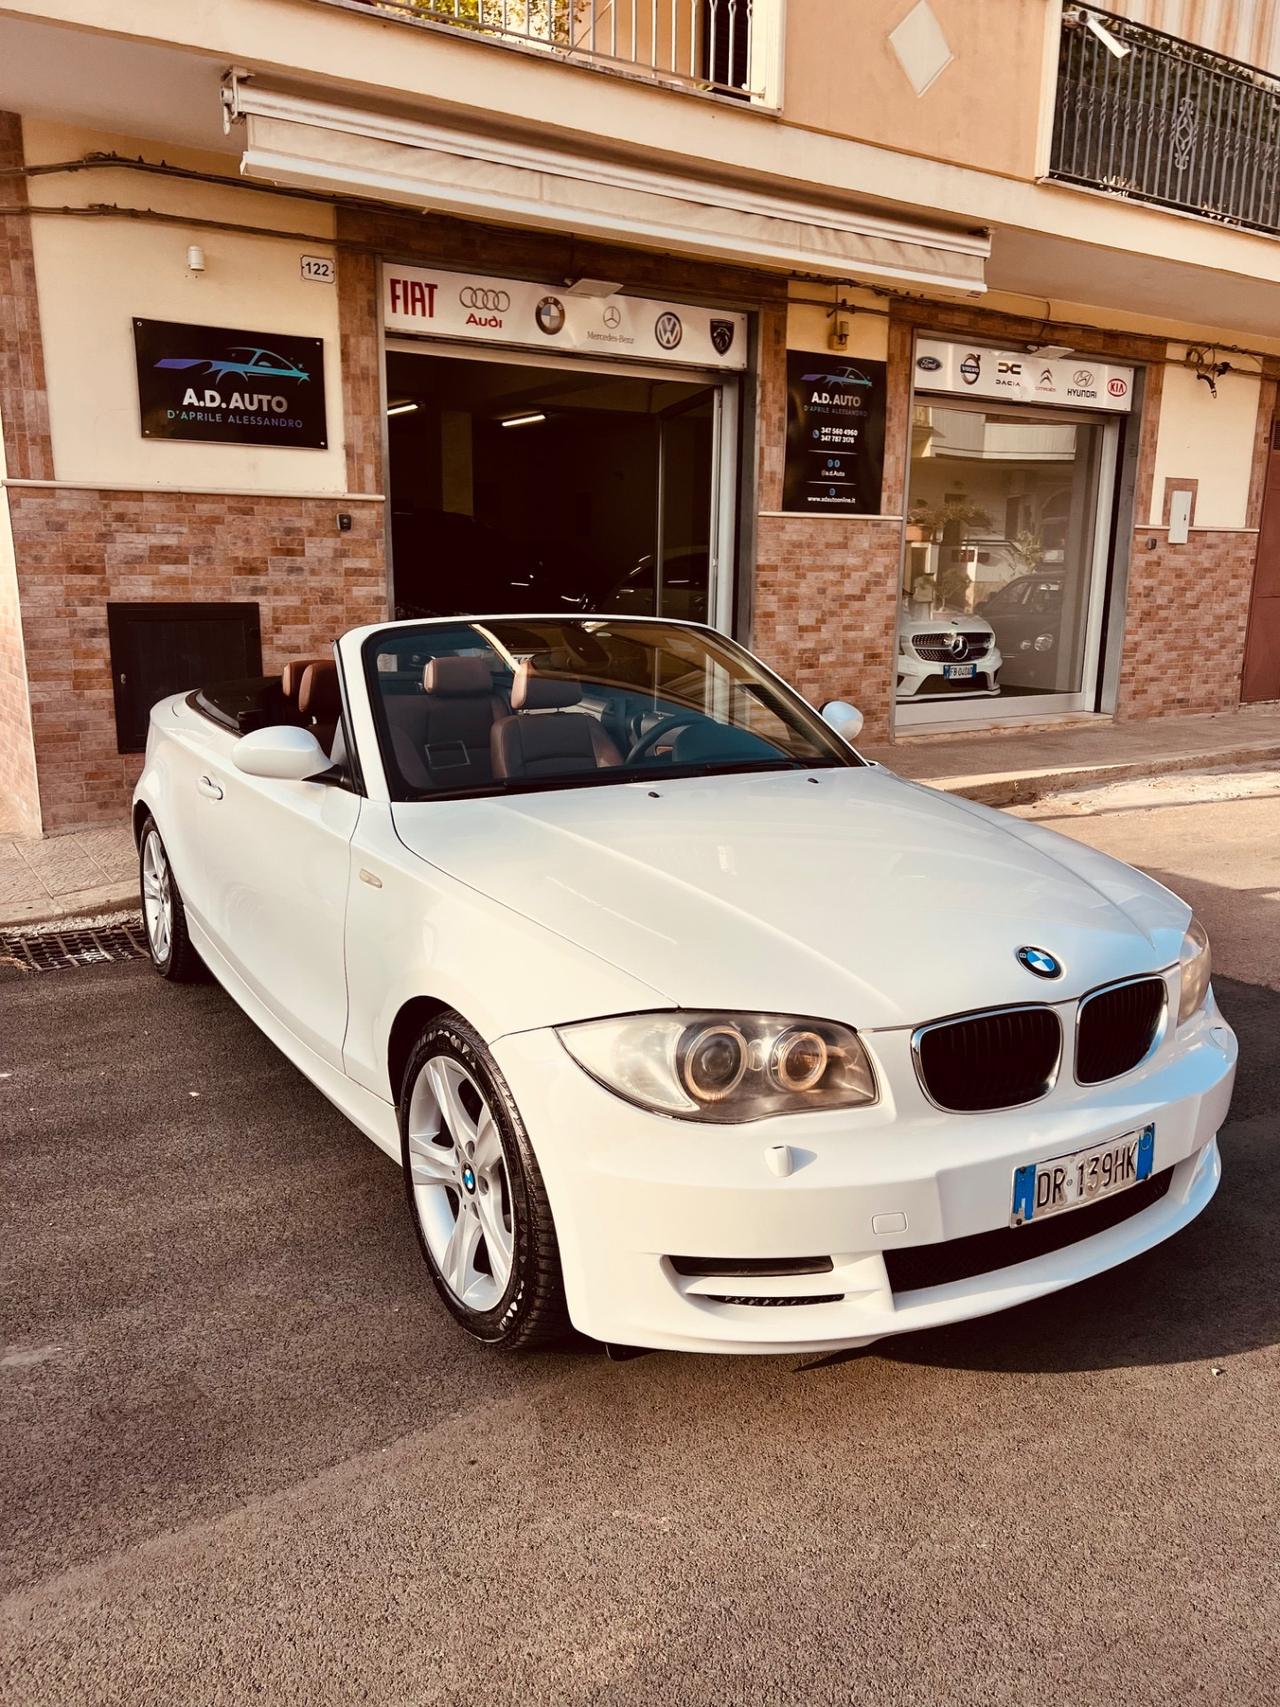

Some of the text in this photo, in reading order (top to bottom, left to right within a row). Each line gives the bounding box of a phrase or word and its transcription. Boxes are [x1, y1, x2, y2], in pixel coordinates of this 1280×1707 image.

[305, 262, 329, 276] 122
[390, 278, 438, 318] FIAT
[466, 313, 502, 328] Audi
[587, 330, 635, 344] Mercedes-Benz
[920, 358, 938, 369] Ford
[995, 379, 1021, 387] DACIA
[1110, 382, 1124, 393] KIA
[182, 388, 288, 413] A.D. AUTO
[811, 391, 861, 407] A.D. AUTO
[1067, 388, 1097, 399] HYUNDAI
[167, 409, 303, 428] D'APRILE ALESSANDRO
[1037, 1168, 1066, 1208] DR
